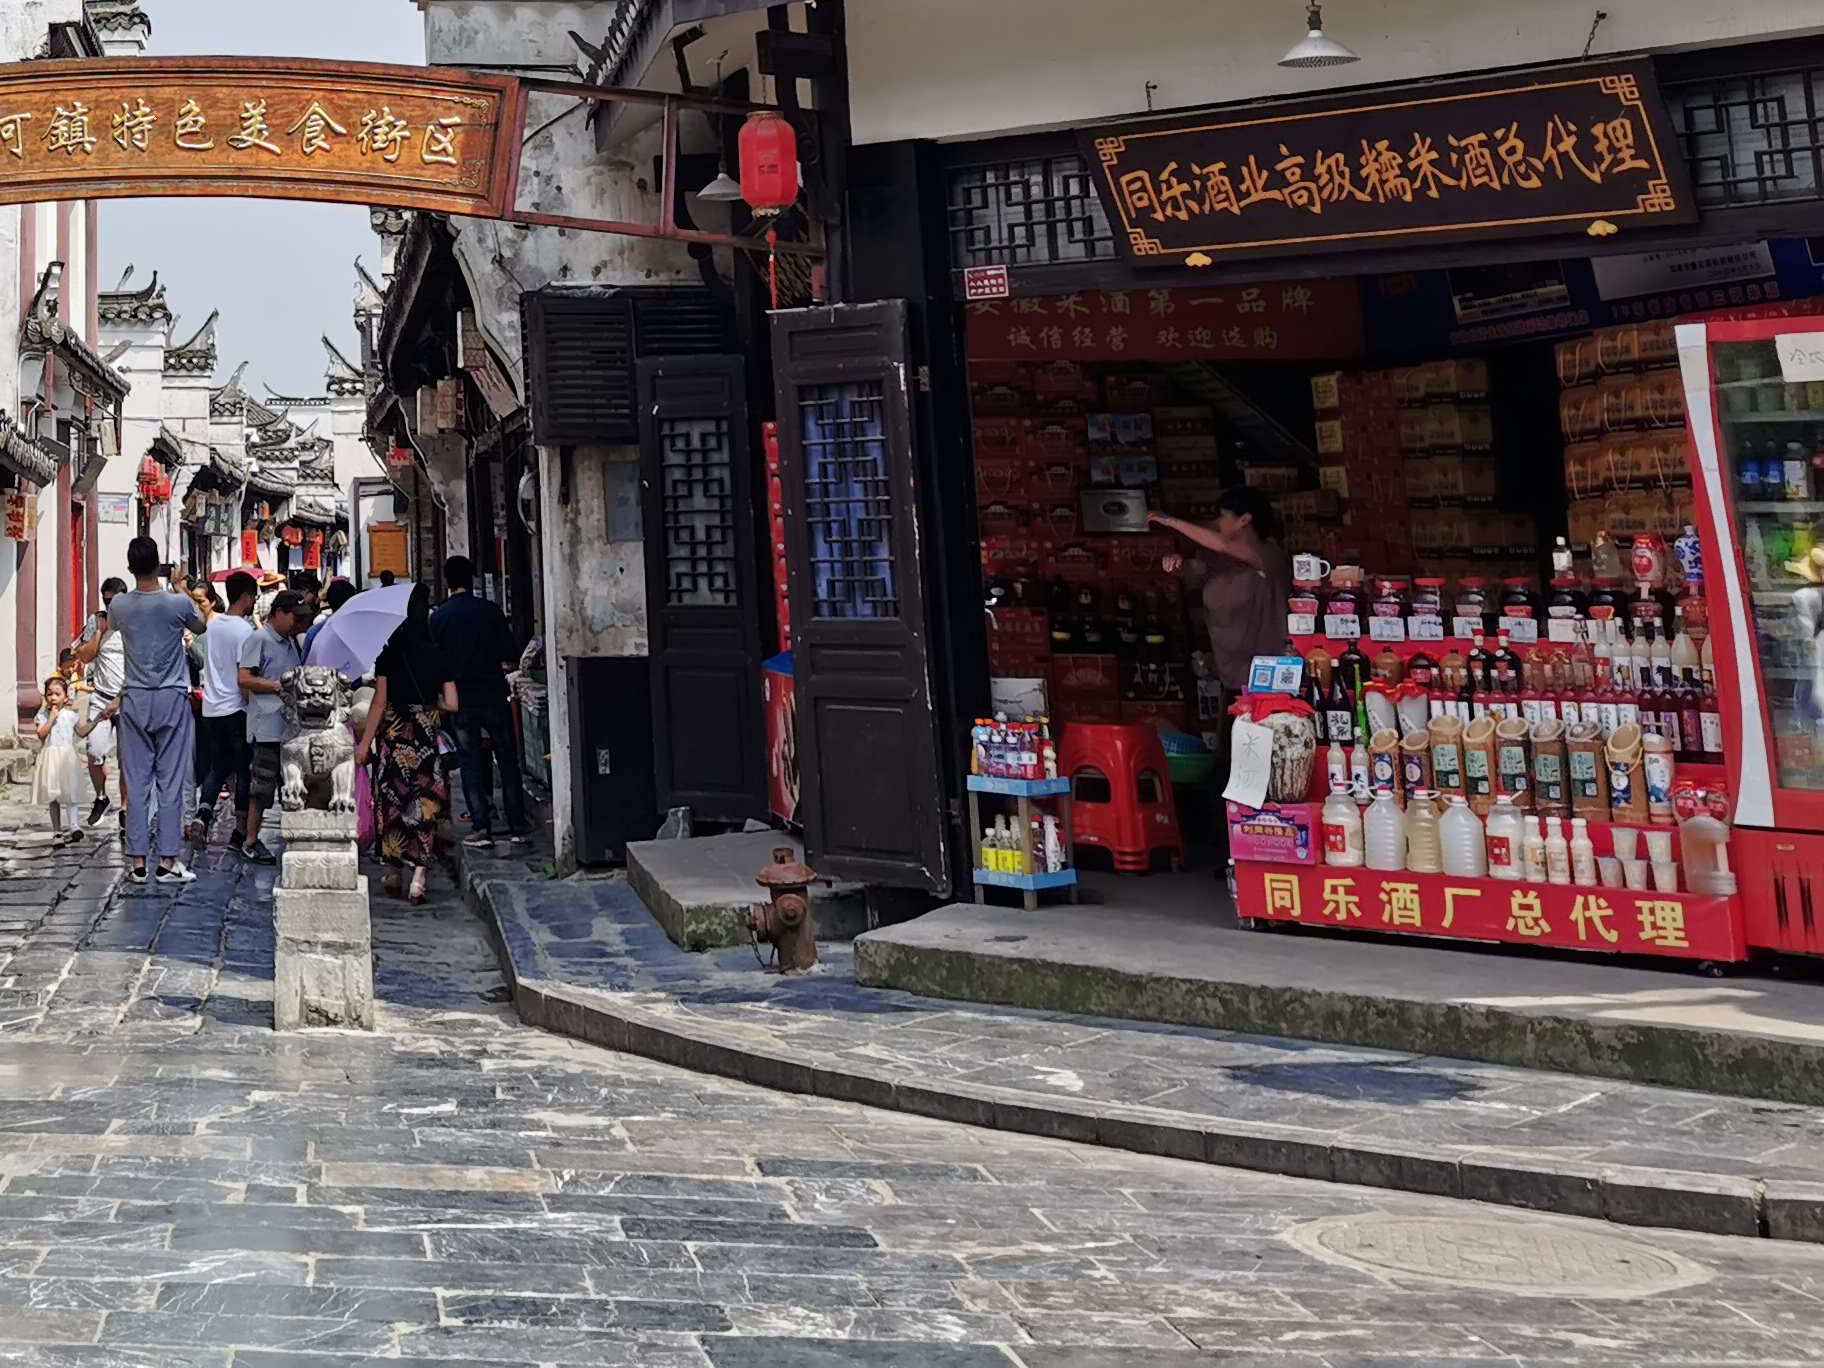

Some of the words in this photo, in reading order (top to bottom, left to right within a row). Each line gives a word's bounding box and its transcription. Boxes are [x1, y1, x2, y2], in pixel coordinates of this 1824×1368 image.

[1119, 113, 1652, 224] 同乐酒业高级糯米酒总代理
[1006, 326, 1130, 352] 诚信经营
[1156, 324, 1280, 350] 欢迎选购
[1263, 872, 1689, 948] 同乐酒厂总代理
